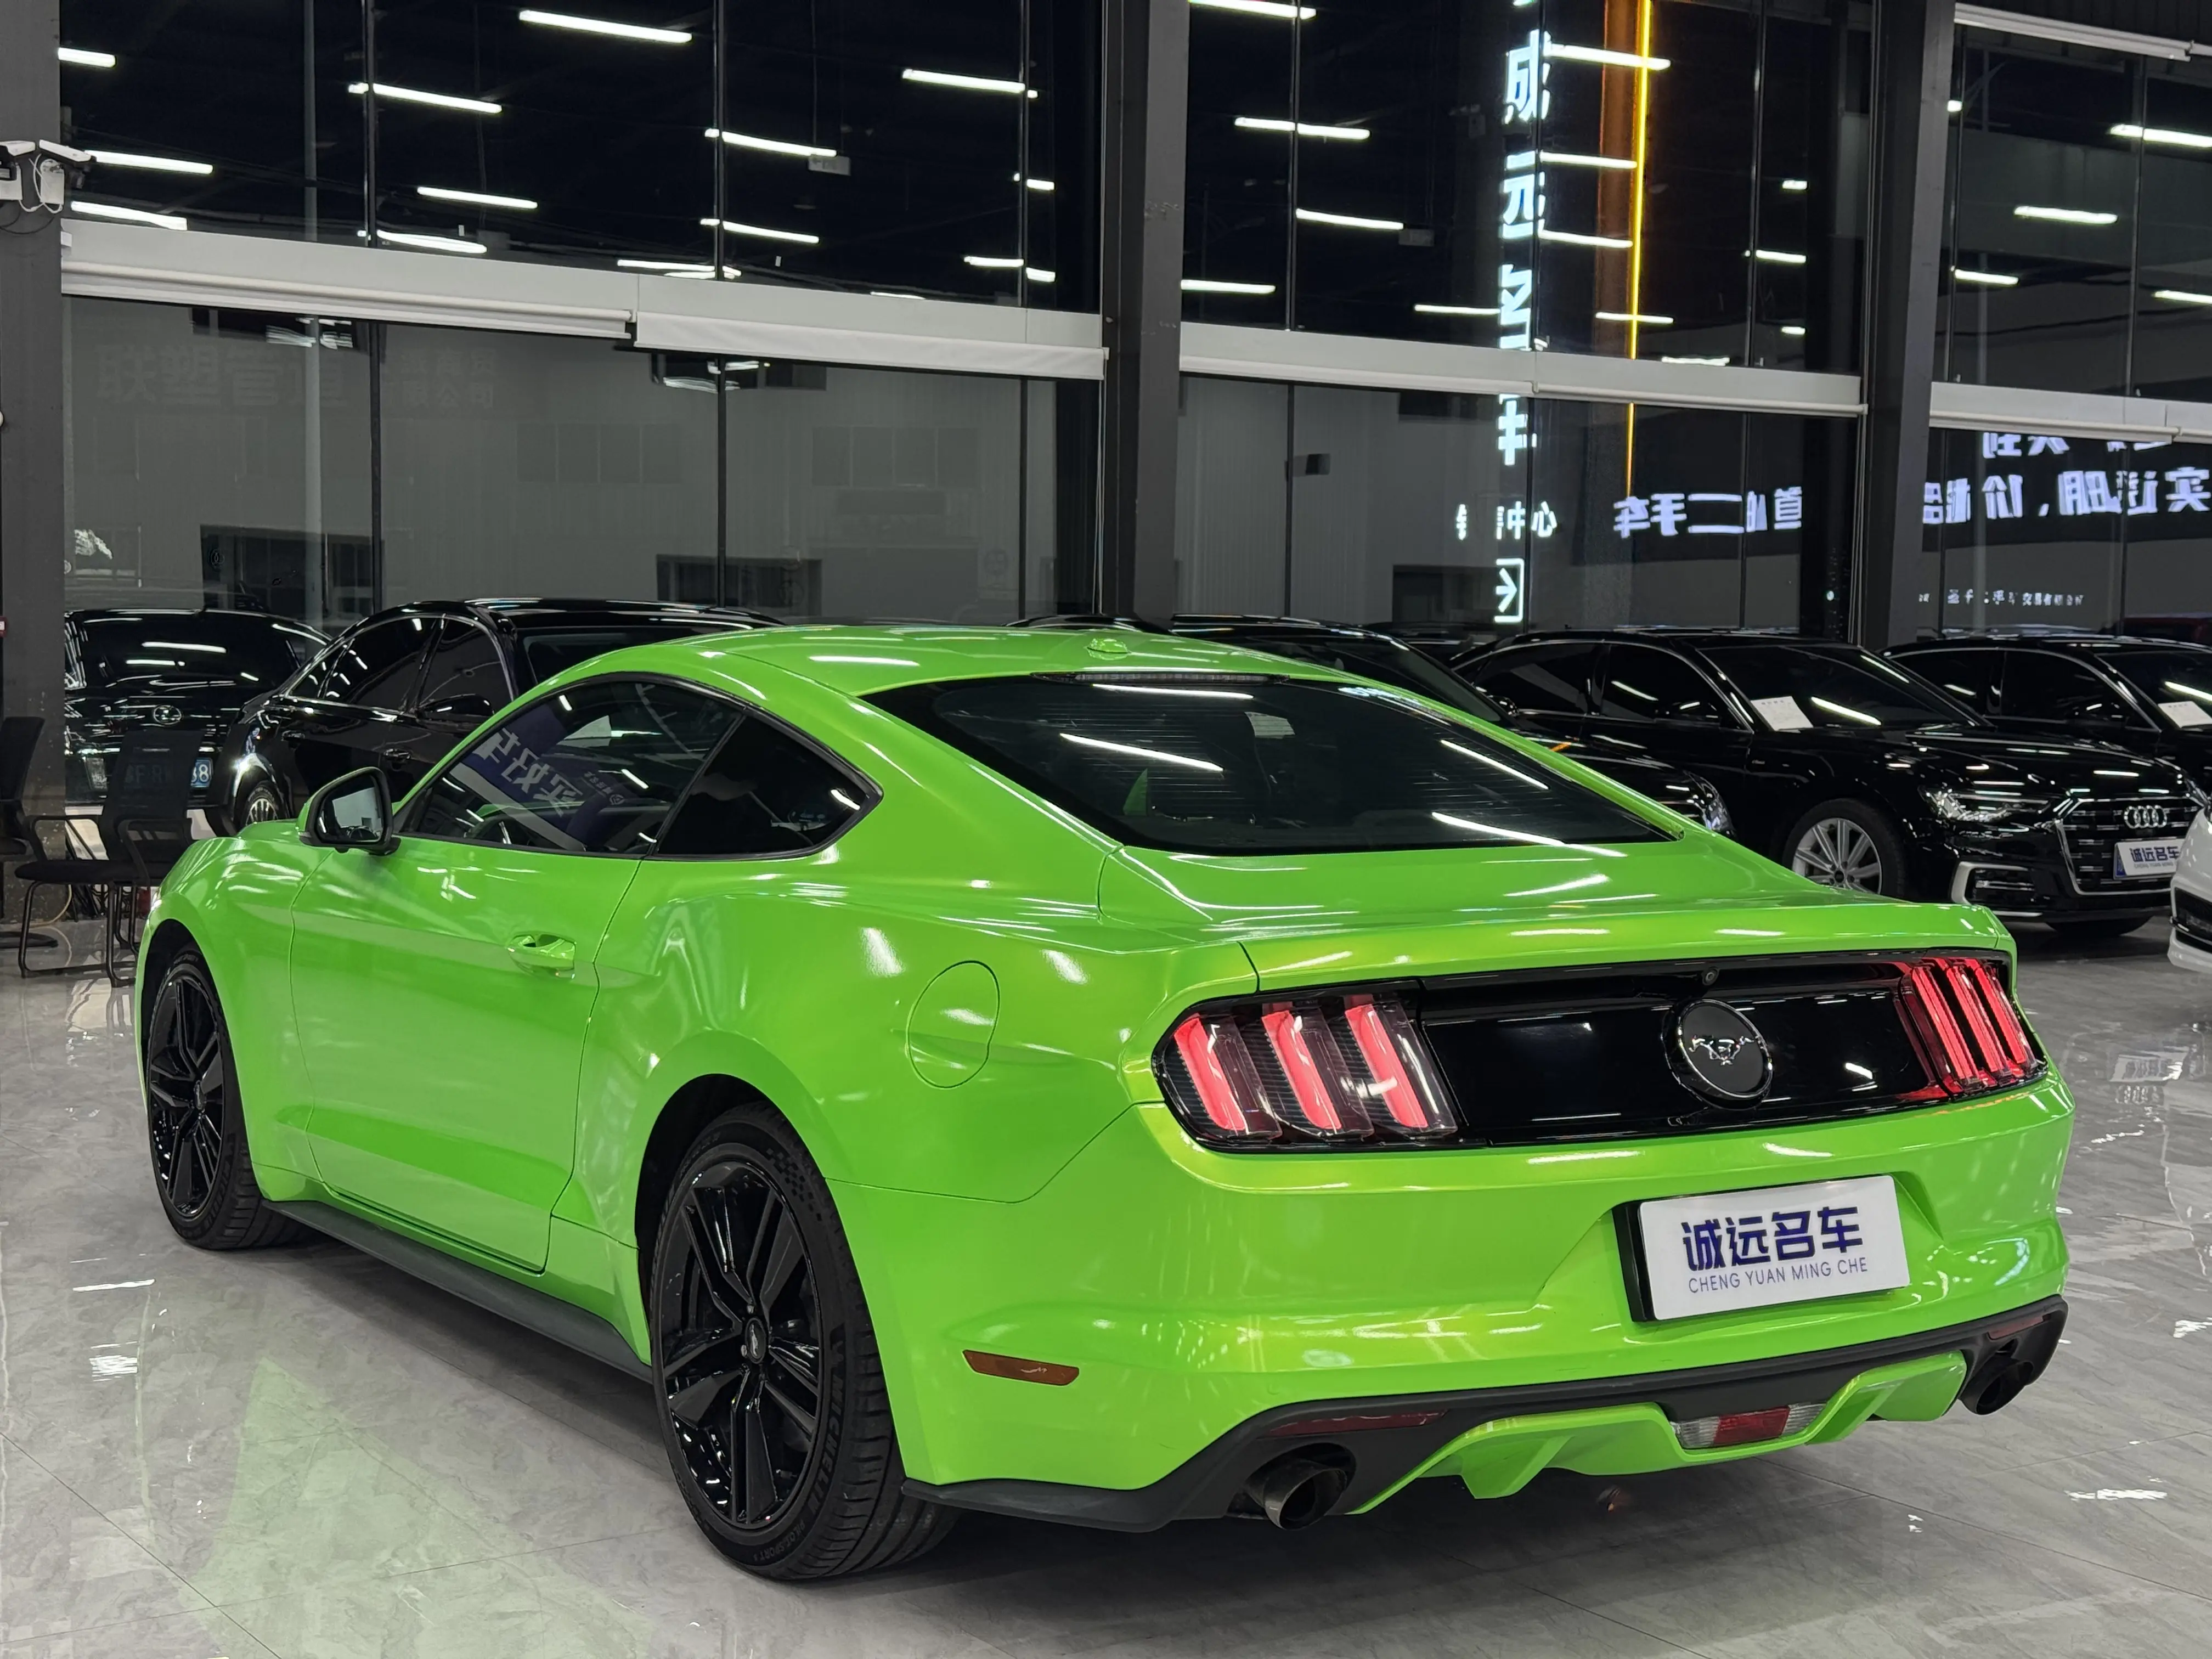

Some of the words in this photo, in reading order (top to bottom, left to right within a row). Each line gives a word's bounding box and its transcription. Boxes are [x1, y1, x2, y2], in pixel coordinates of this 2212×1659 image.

[2129, 845, 2180, 862] 诚远名车
[1681, 1206, 1863, 1271] 诚远名车
[1688, 1271, 1741, 1294] CHENG
[1745, 1266, 1785, 1286] YUAN
[1792, 1261, 1832, 1279] MING
[1838, 1256, 1868, 1275] CHE
[808, 1374, 844, 1516] MICHELIN
